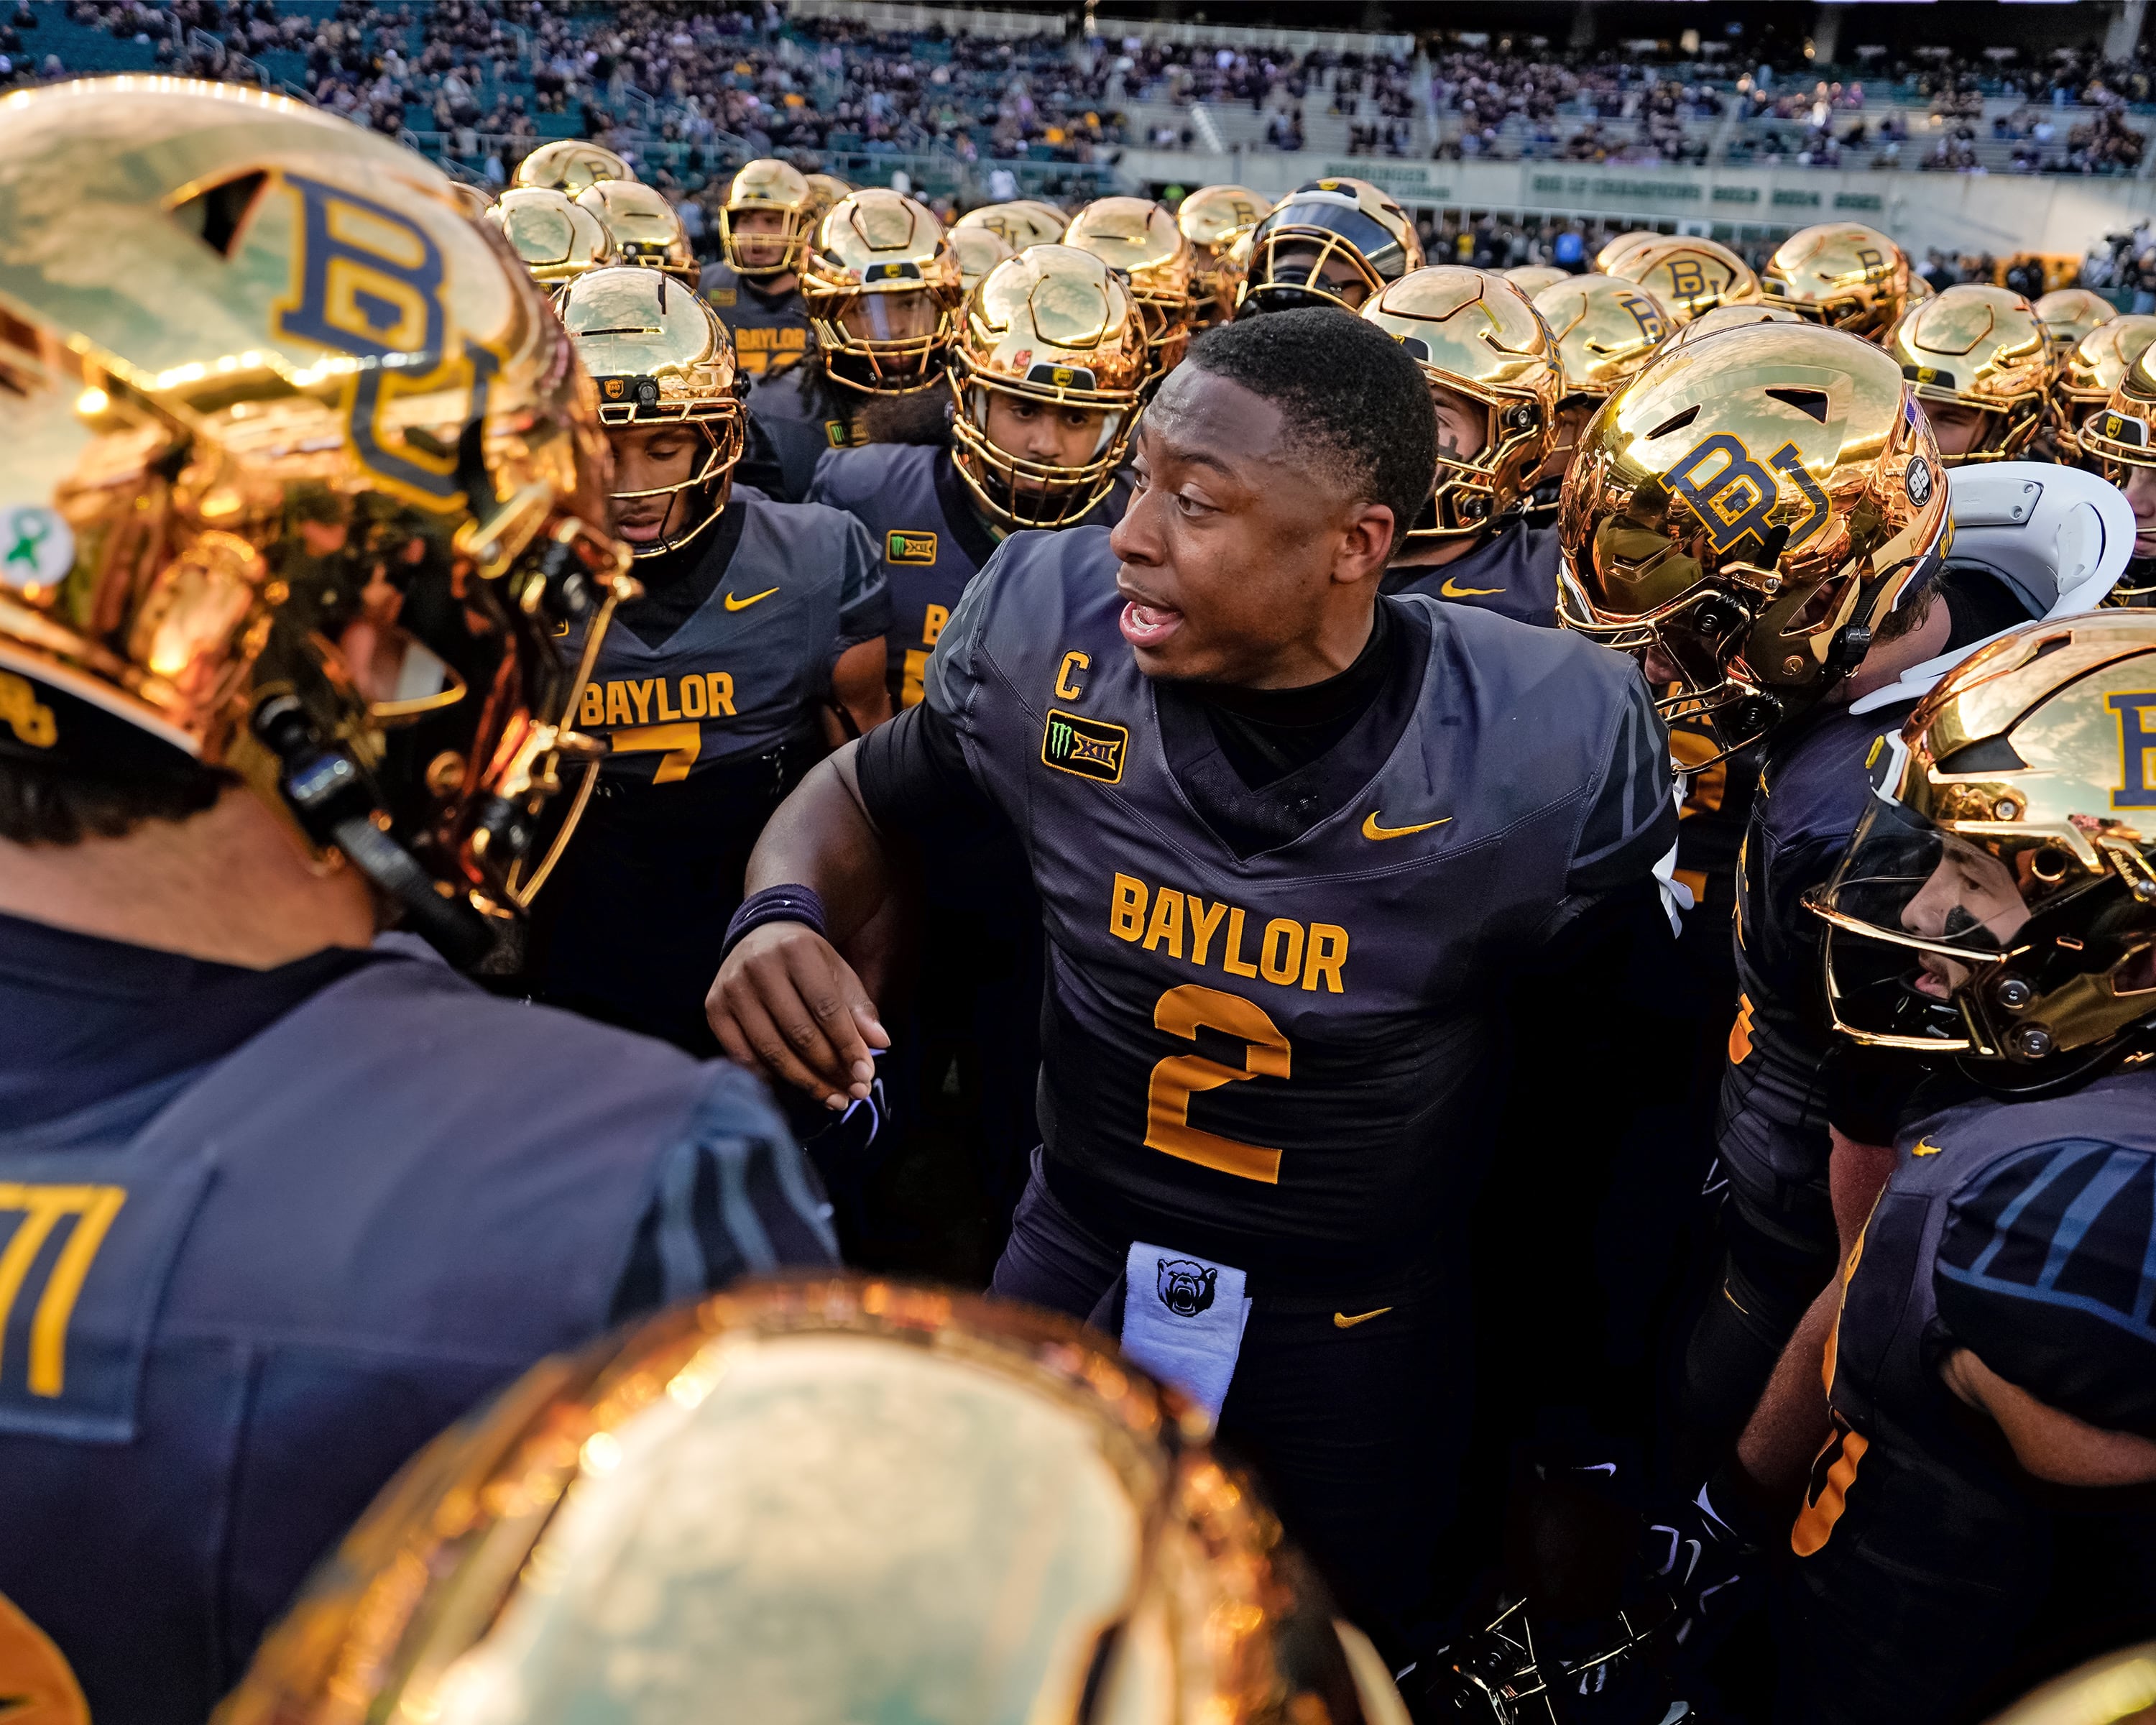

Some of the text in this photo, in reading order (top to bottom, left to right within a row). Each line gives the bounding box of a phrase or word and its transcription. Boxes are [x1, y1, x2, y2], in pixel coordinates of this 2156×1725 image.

[736, 328, 806, 351] BAYLOR
[580, 671, 737, 727] BAYLOR
[1054, 650, 1090, 700] C
[611, 722, 701, 785] 7
[1110, 872, 1349, 993] BAYLOR
[1143, 984, 1291, 1184] 2
